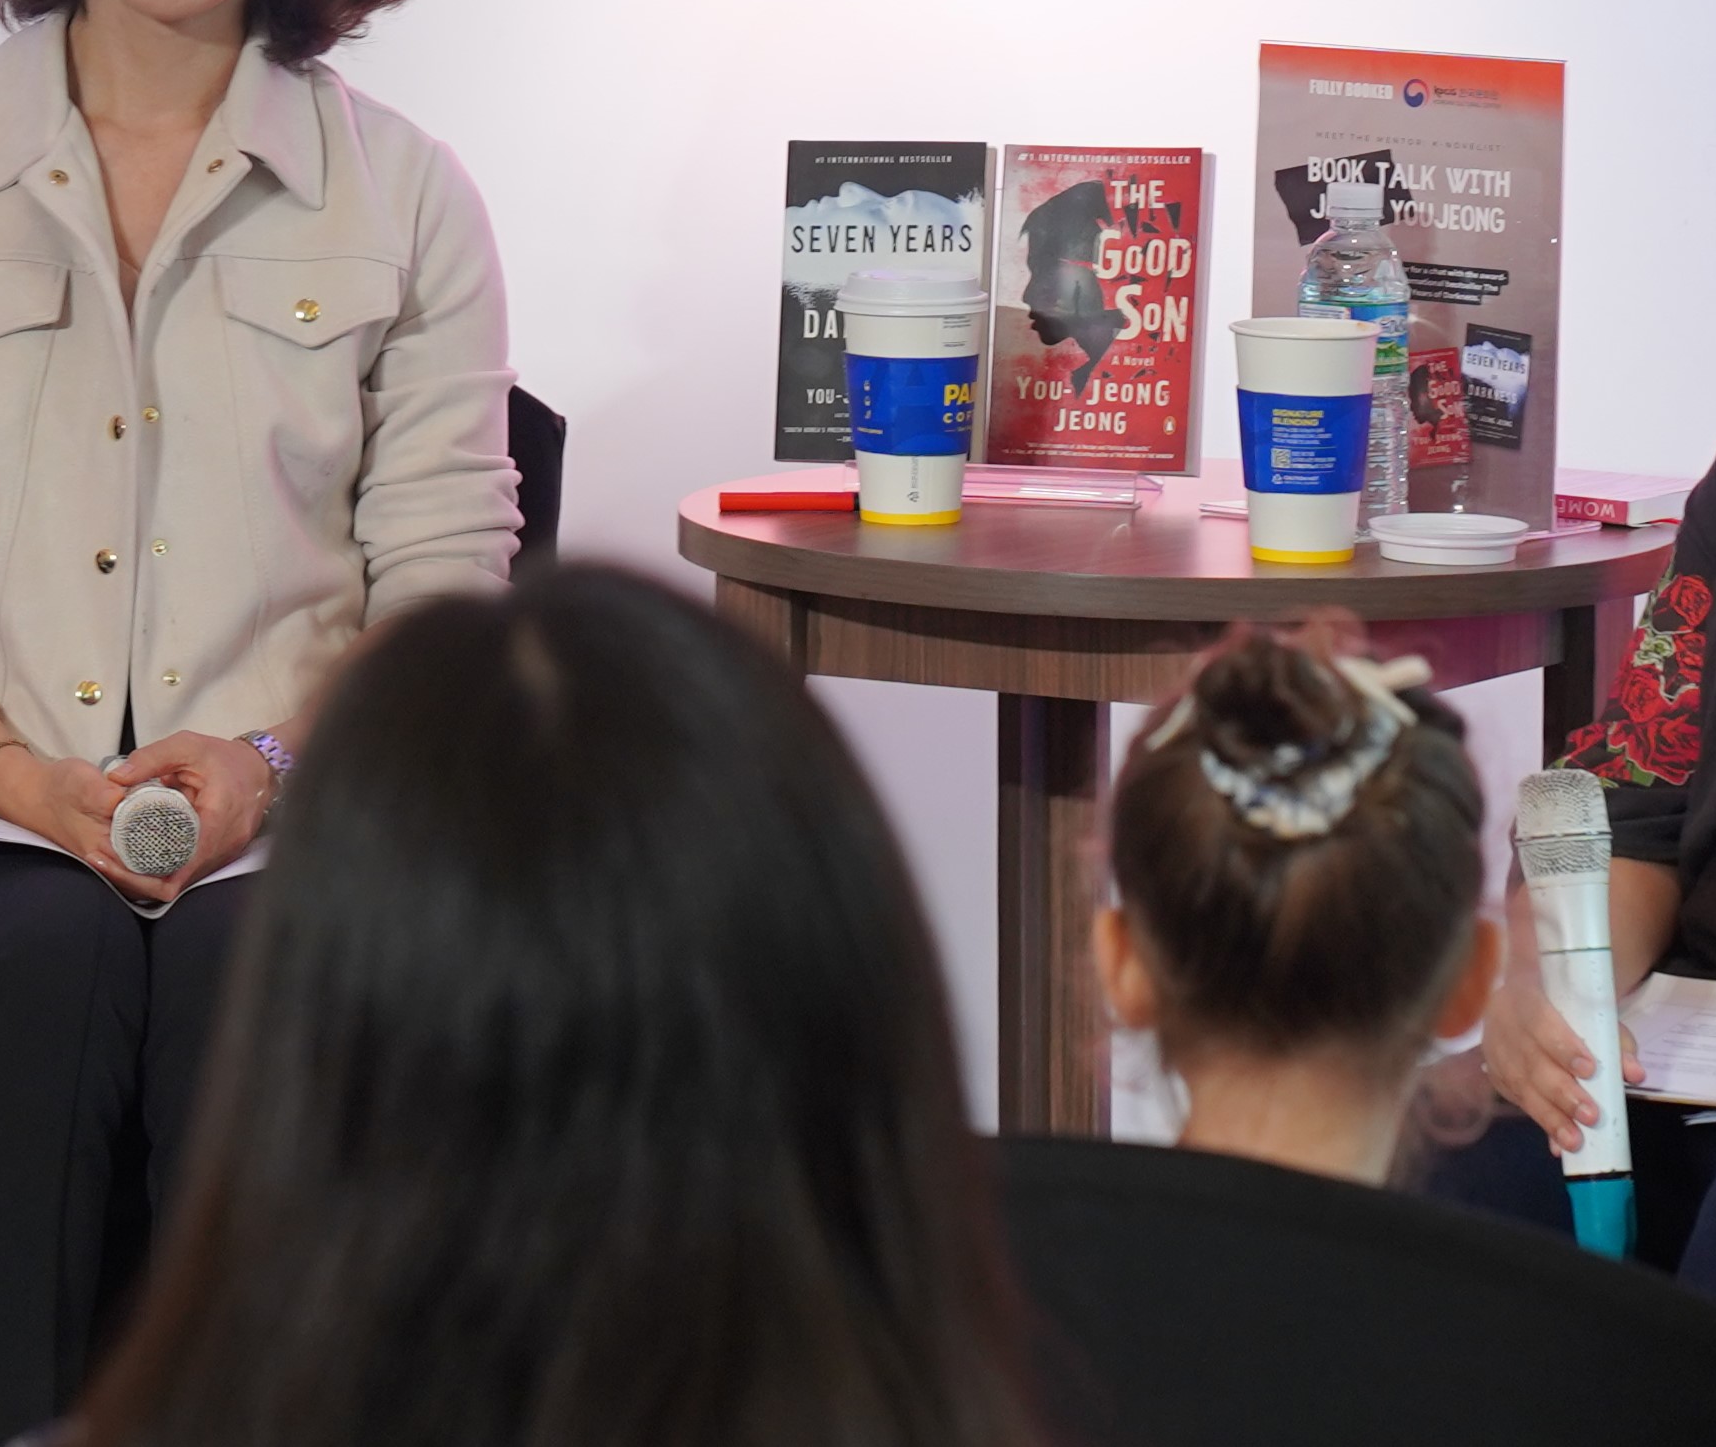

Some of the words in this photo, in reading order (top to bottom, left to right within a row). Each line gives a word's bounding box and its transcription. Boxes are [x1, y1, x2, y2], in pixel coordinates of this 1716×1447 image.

[1309, 78, 1344, 95] FULLY
[1345, 82, 1394, 100] BOOKED
[1039, 154, 1122, 163] INTERNATIONAL
[1127, 155, 1191, 164] BESTSELLER
[1307, 156, 1367, 184] BOOK
[1375, 162, 1437, 190] TALK
[1445, 167, 1511, 197] WITH
[1110, 180, 1165, 209] THE
[1390, 199, 1505, 234] YOUJEONG
[791, 225, 875, 253] SEVEN
[890, 224, 973, 252] YEARS
[1466, 353, 1494, 368] SEVEN
[1497, 359, 1526, 374] YEARS
[1468, 383, 1518, 404] DARKNESS
[1053, 408, 1127, 435] JEONG
